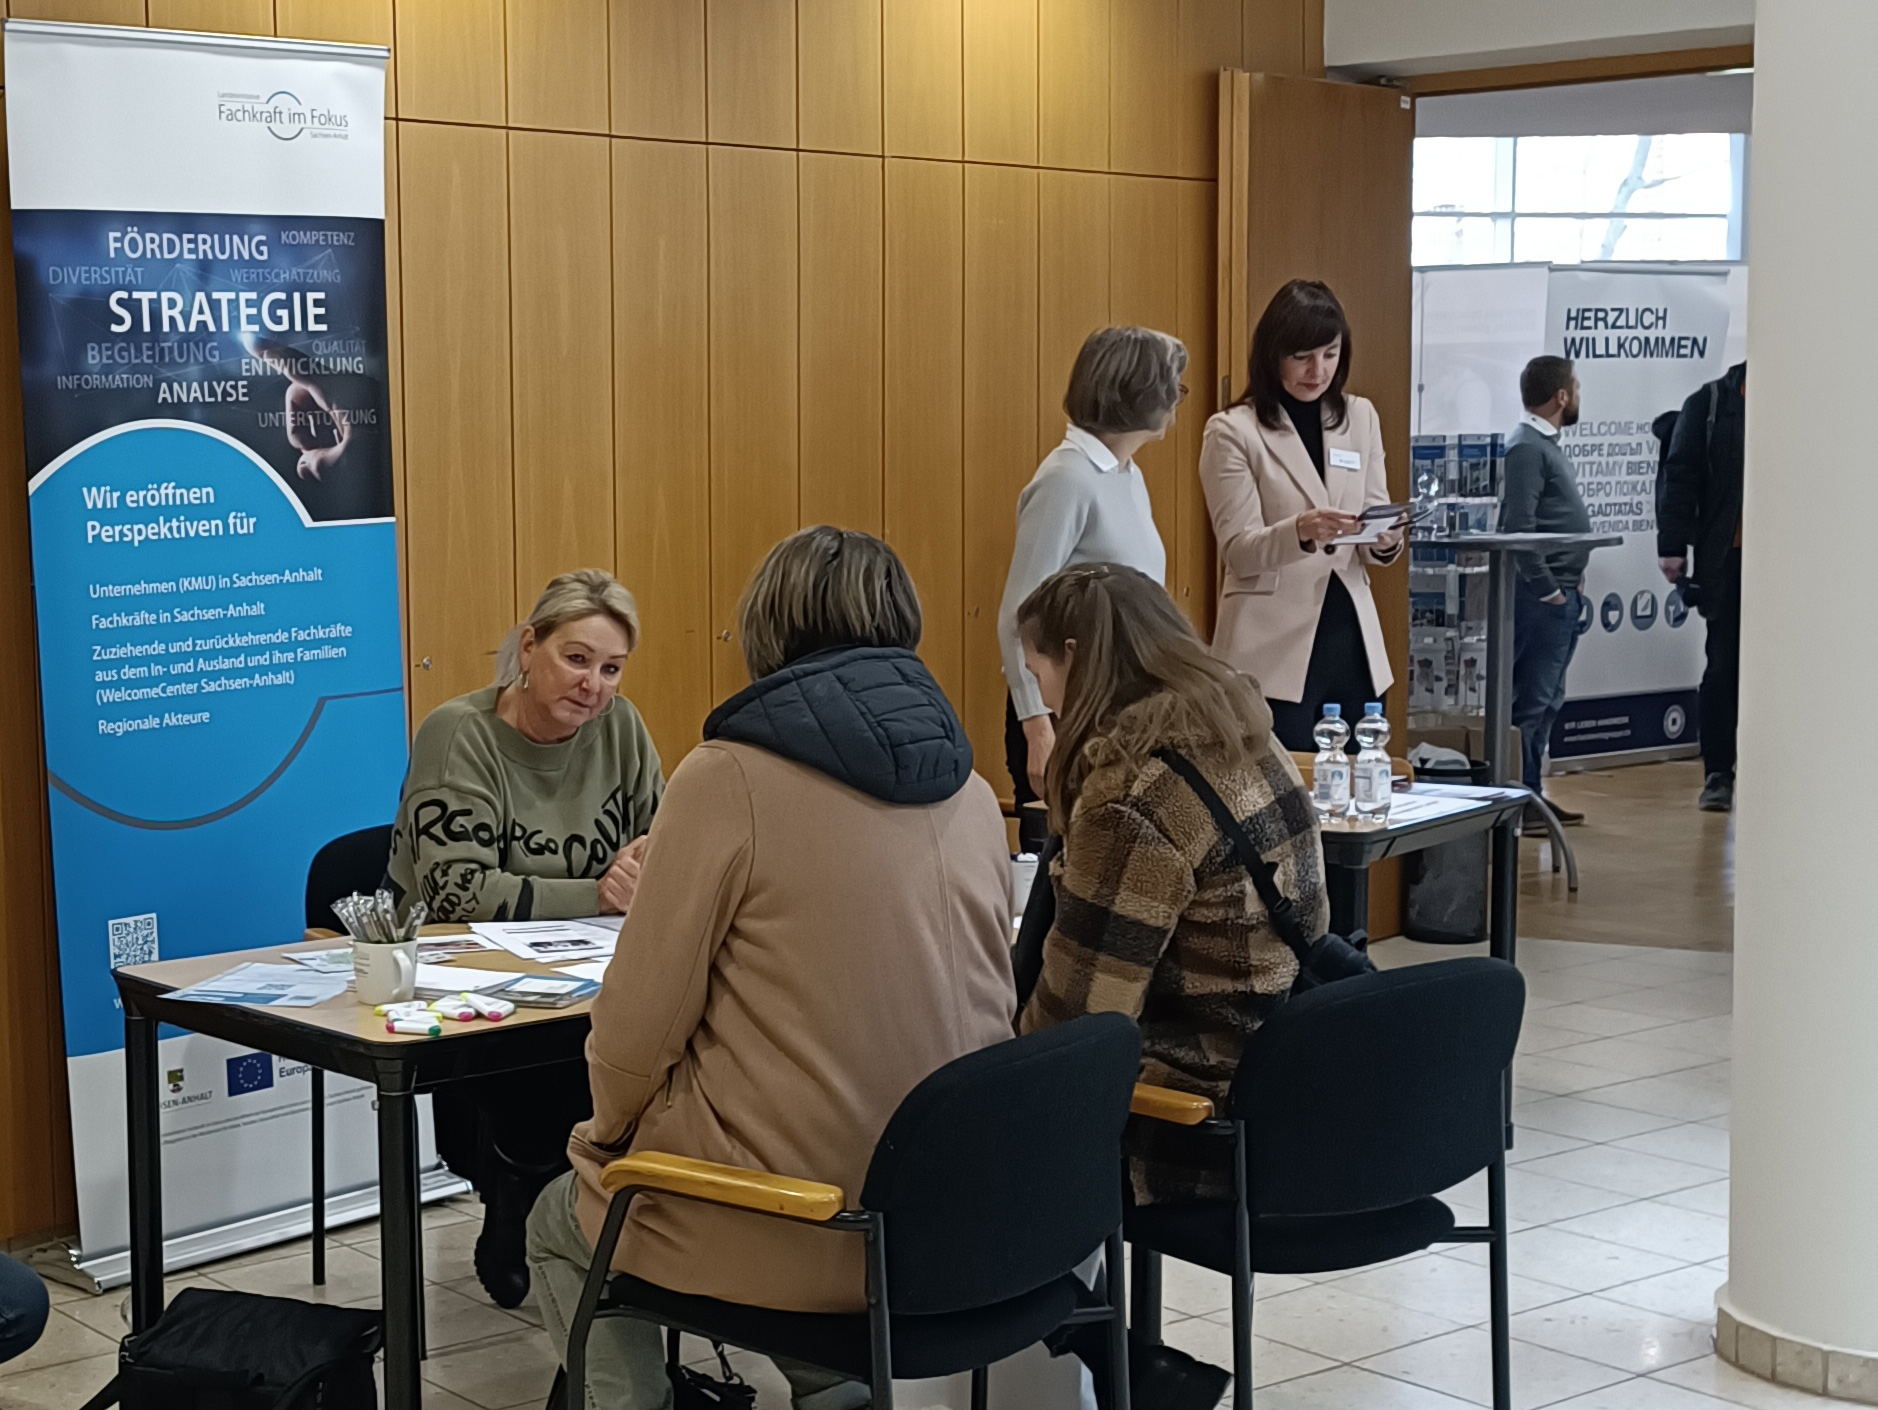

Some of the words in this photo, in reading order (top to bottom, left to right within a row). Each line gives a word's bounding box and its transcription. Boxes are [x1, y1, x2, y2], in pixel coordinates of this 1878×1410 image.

[218, 104, 284, 124] Fachkraft
[287, 108, 306, 124] im
[310, 109, 349, 127] Fokus
[108, 226, 268, 260] FÖRDERUNG
[281, 231, 355, 246] KOMPETENZ
[48, 263, 144, 285] DIVERSITÄT
[230, 265, 341, 284] WERTSCHÄTZUNG
[109, 291, 328, 333] STRATEGIE
[1565, 307, 1668, 330] HERZLICH
[87, 342, 220, 365] BEGLEITUNG
[1563, 335, 1708, 359] WILLKOMMEN
[241, 356, 364, 377] ENTWICKLUNG
[57, 374, 154, 390] INFORMATION
[158, 380, 249, 404] ANALYSE
[1563, 421, 1635, 437] WELCOME
[82, 486, 119, 510] Wir
[125, 482, 215, 507] eröffnen
[86, 516, 222, 546] Perspektiven
[227, 513, 257, 535] für
[89, 579, 177, 598] Unternehmen
[179, 575, 217, 594] (KMU)
[219, 574, 230, 589] in
[233, 566, 323, 588] Sachsen-Anhalt
[91, 610, 157, 630] Fachkräfte
[160, 608, 171, 624] in
[174, 601, 265, 623] Sachsen-Anhalt
[92, 640, 166, 661] Zuziehende
[168, 636, 193, 654] und
[195, 628, 289, 651] zurückkehrende
[291, 622, 352, 642] Fachkräfte
[95, 668, 118, 682] aus
[120, 664, 148, 680] dem
[151, 662, 167, 677] In-
[170, 658, 194, 675] und
[196, 652, 245, 673] Ausland
[247, 648, 270, 667] und
[272, 648, 295, 665] ihre
[297, 645, 347, 663] Familien
[96, 681, 198, 705] (WelcomeCenter
[200, 670, 295, 694] Sachsen-Anhalt)
[98, 715, 160, 737] Regionale
[162, 711, 210, 728] Akteure
